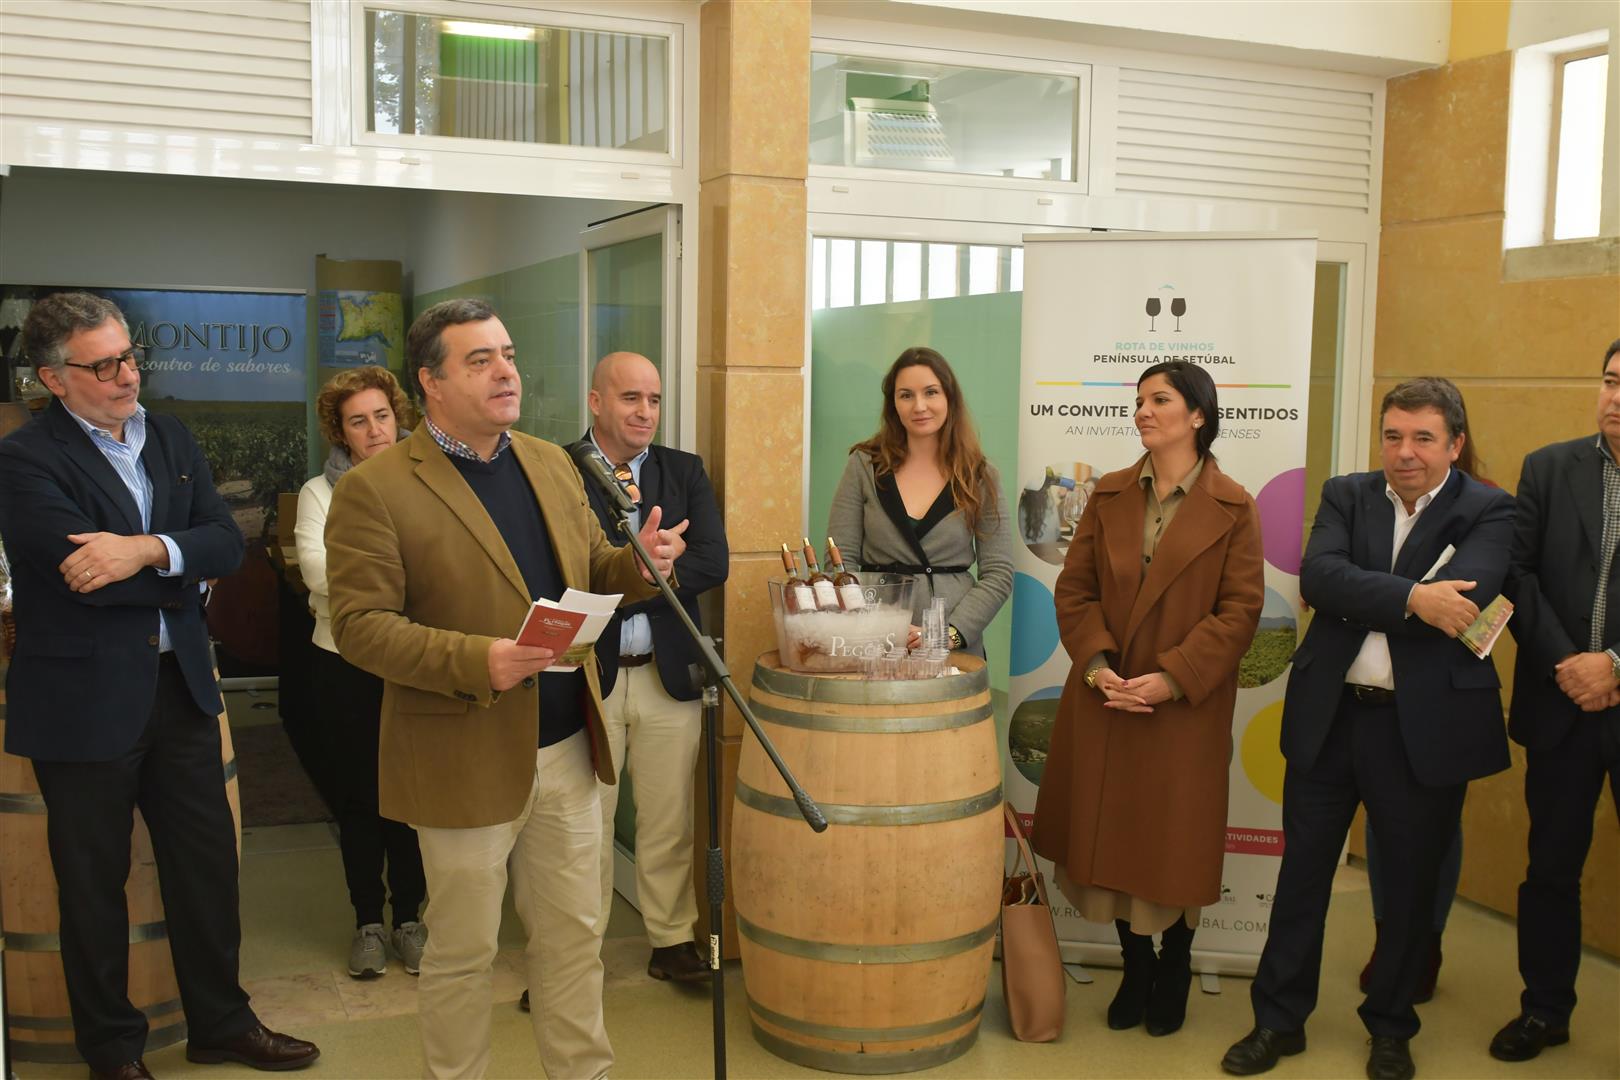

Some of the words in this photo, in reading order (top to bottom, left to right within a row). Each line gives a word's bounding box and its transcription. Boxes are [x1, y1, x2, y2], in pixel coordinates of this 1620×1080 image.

[1115, 341, 1146, 351] ROTA
[1150, 341, 1165, 351] DE
[1168, 341, 1215, 352] VINHOS
[1093, 353, 1160, 363] PENÍNSULA
[1164, 354, 1180, 363] DE
[1182, 353, 1236, 364] SETÚBAL
[138, 357, 194, 372] contro
[200, 357, 222, 372] de
[226, 358, 291, 374] sabores
[1030, 404, 1053, 416] UM
[1058, 404, 1129, 417] CONVITE
[1217, 407, 1299, 421] SENTIDOS
[1065, 425, 1084, 435] AN
[1225, 832, 1279, 844] TIVIDADES
